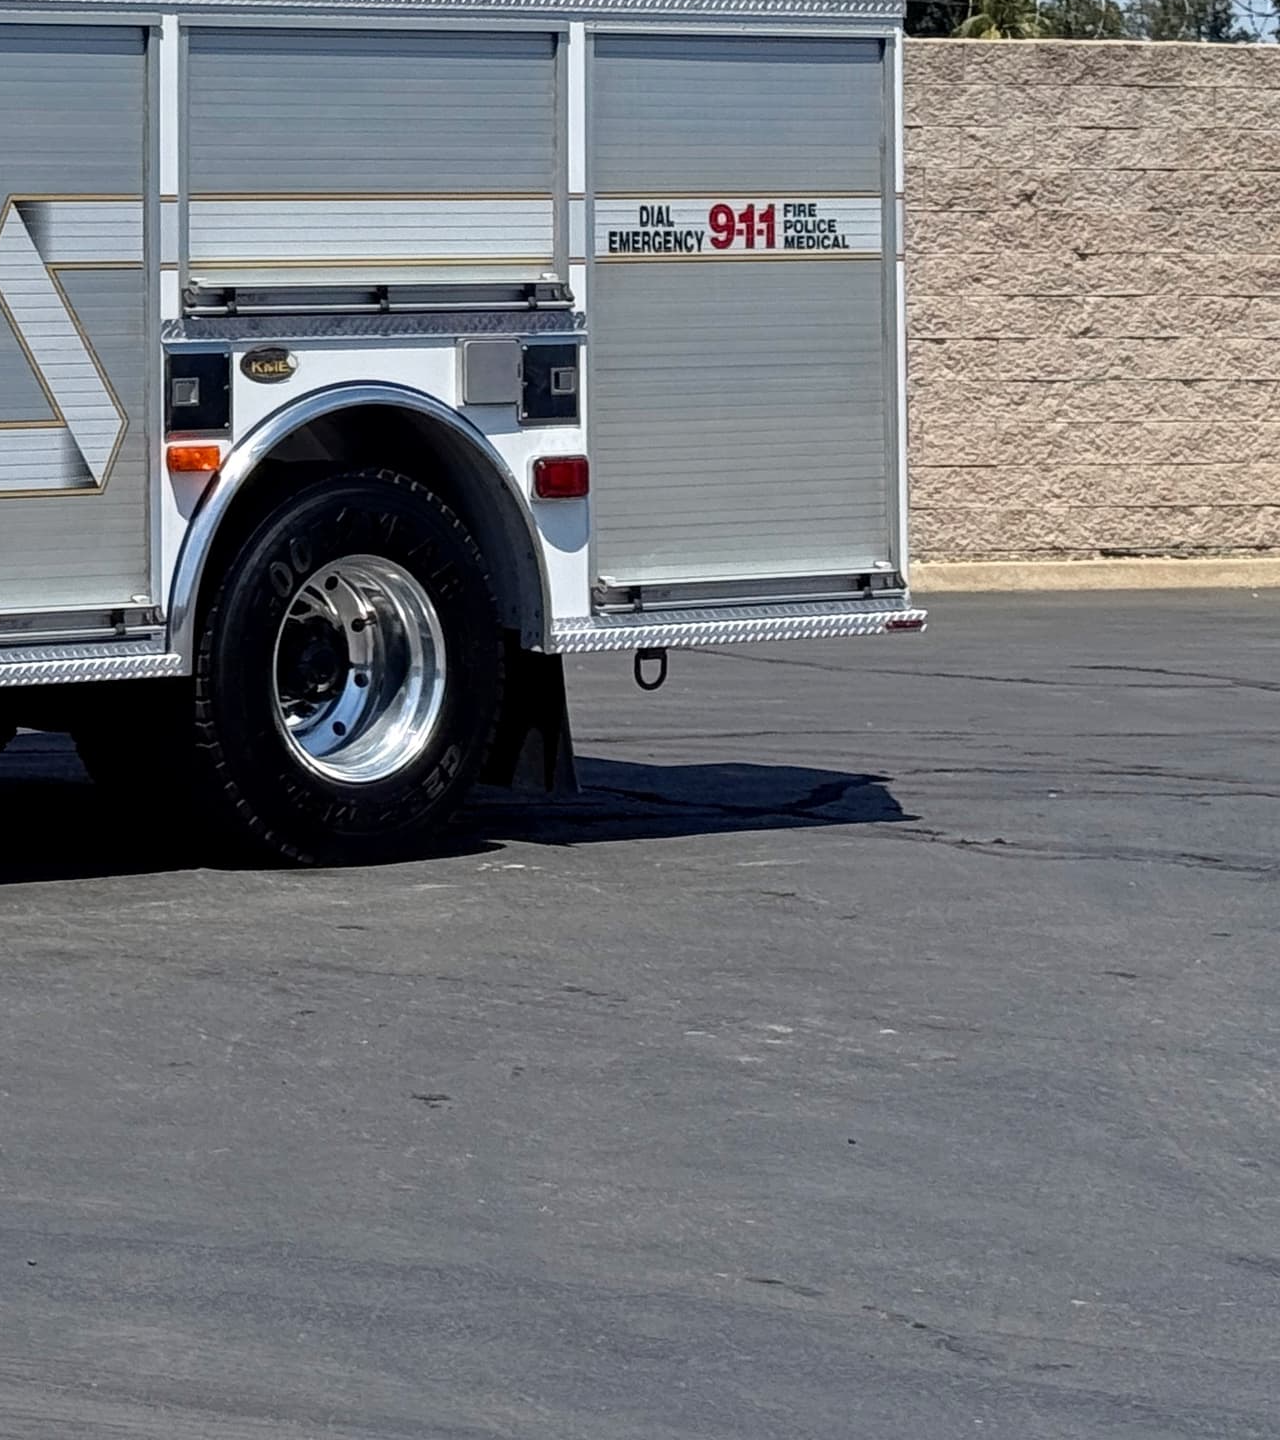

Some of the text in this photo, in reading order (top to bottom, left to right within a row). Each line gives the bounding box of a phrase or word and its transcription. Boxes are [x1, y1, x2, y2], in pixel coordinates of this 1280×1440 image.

[639, 205, 675, 228] DIAL
[783, 203, 818, 218] FIRE
[708, 203, 776, 250] 9-1-1
[783, 219, 838, 234] POLICE
[608, 230, 705, 253] EMERGENCY
[783, 235, 850, 250] MEDICAL
[251, 361, 289, 373] KME
